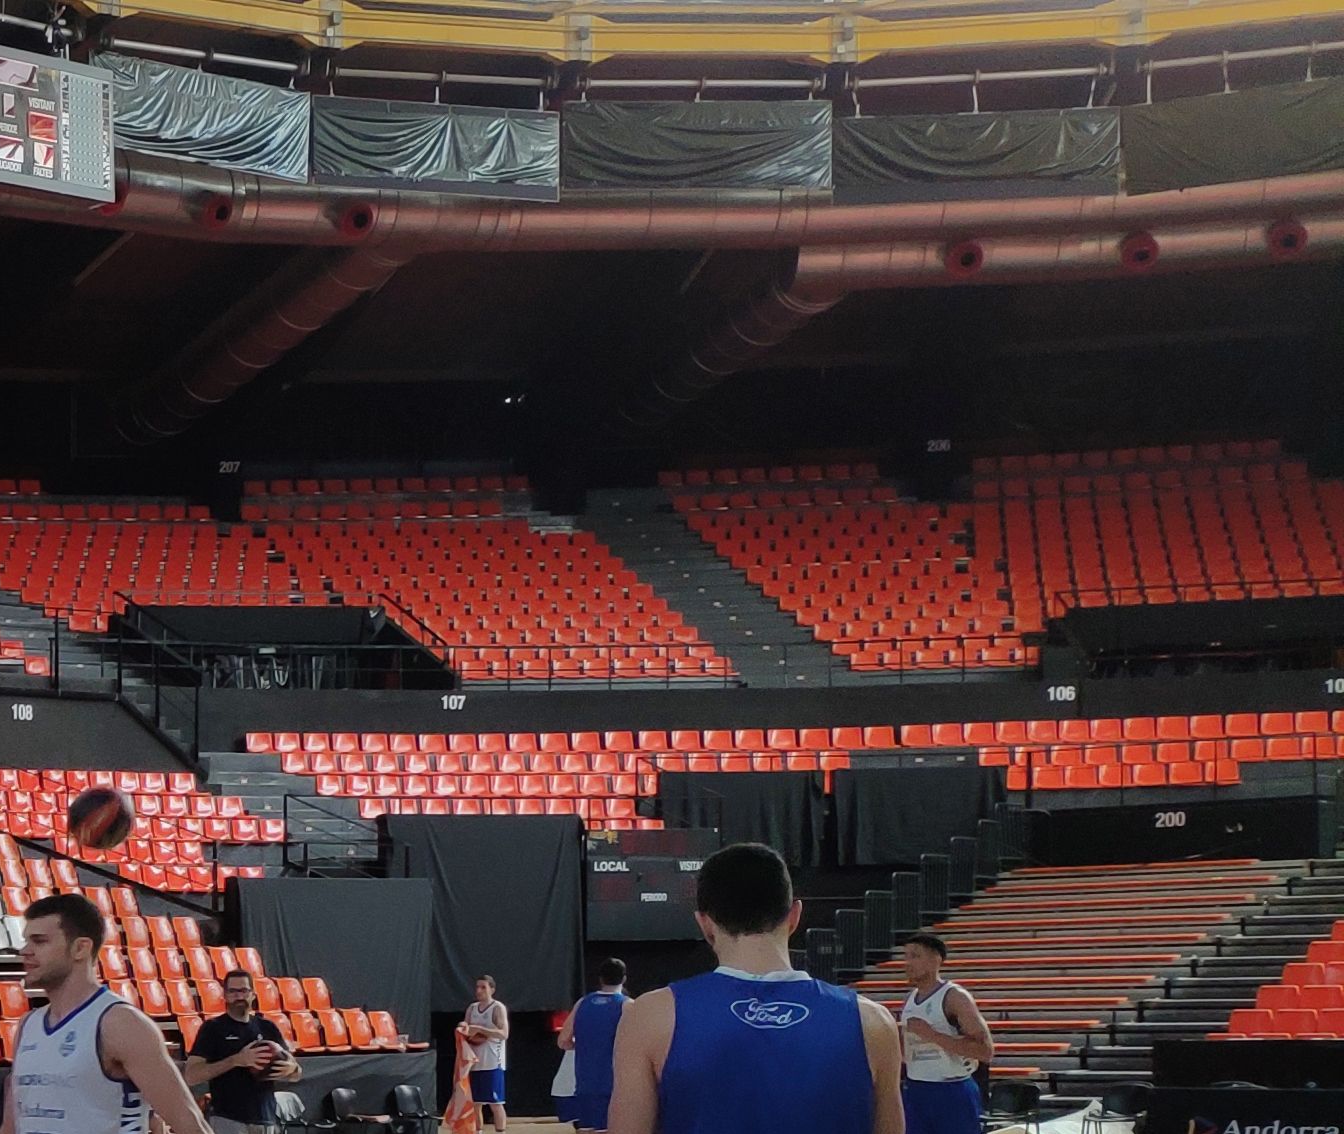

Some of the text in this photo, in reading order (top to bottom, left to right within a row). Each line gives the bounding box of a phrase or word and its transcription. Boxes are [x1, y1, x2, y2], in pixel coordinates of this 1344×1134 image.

[28, 96, 55, 111] VISITANT
[219, 461, 241, 473] 207
[1047, 685, 1076, 701] 106
[441, 694, 467, 710] 107
[11, 703, 34, 721] 108
[1155, 811, 1186, 828] 200
[593, 861, 630, 872] LOCAL
[679, 861, 704, 871] VISITA
[744, 997, 794, 1025] Ford
